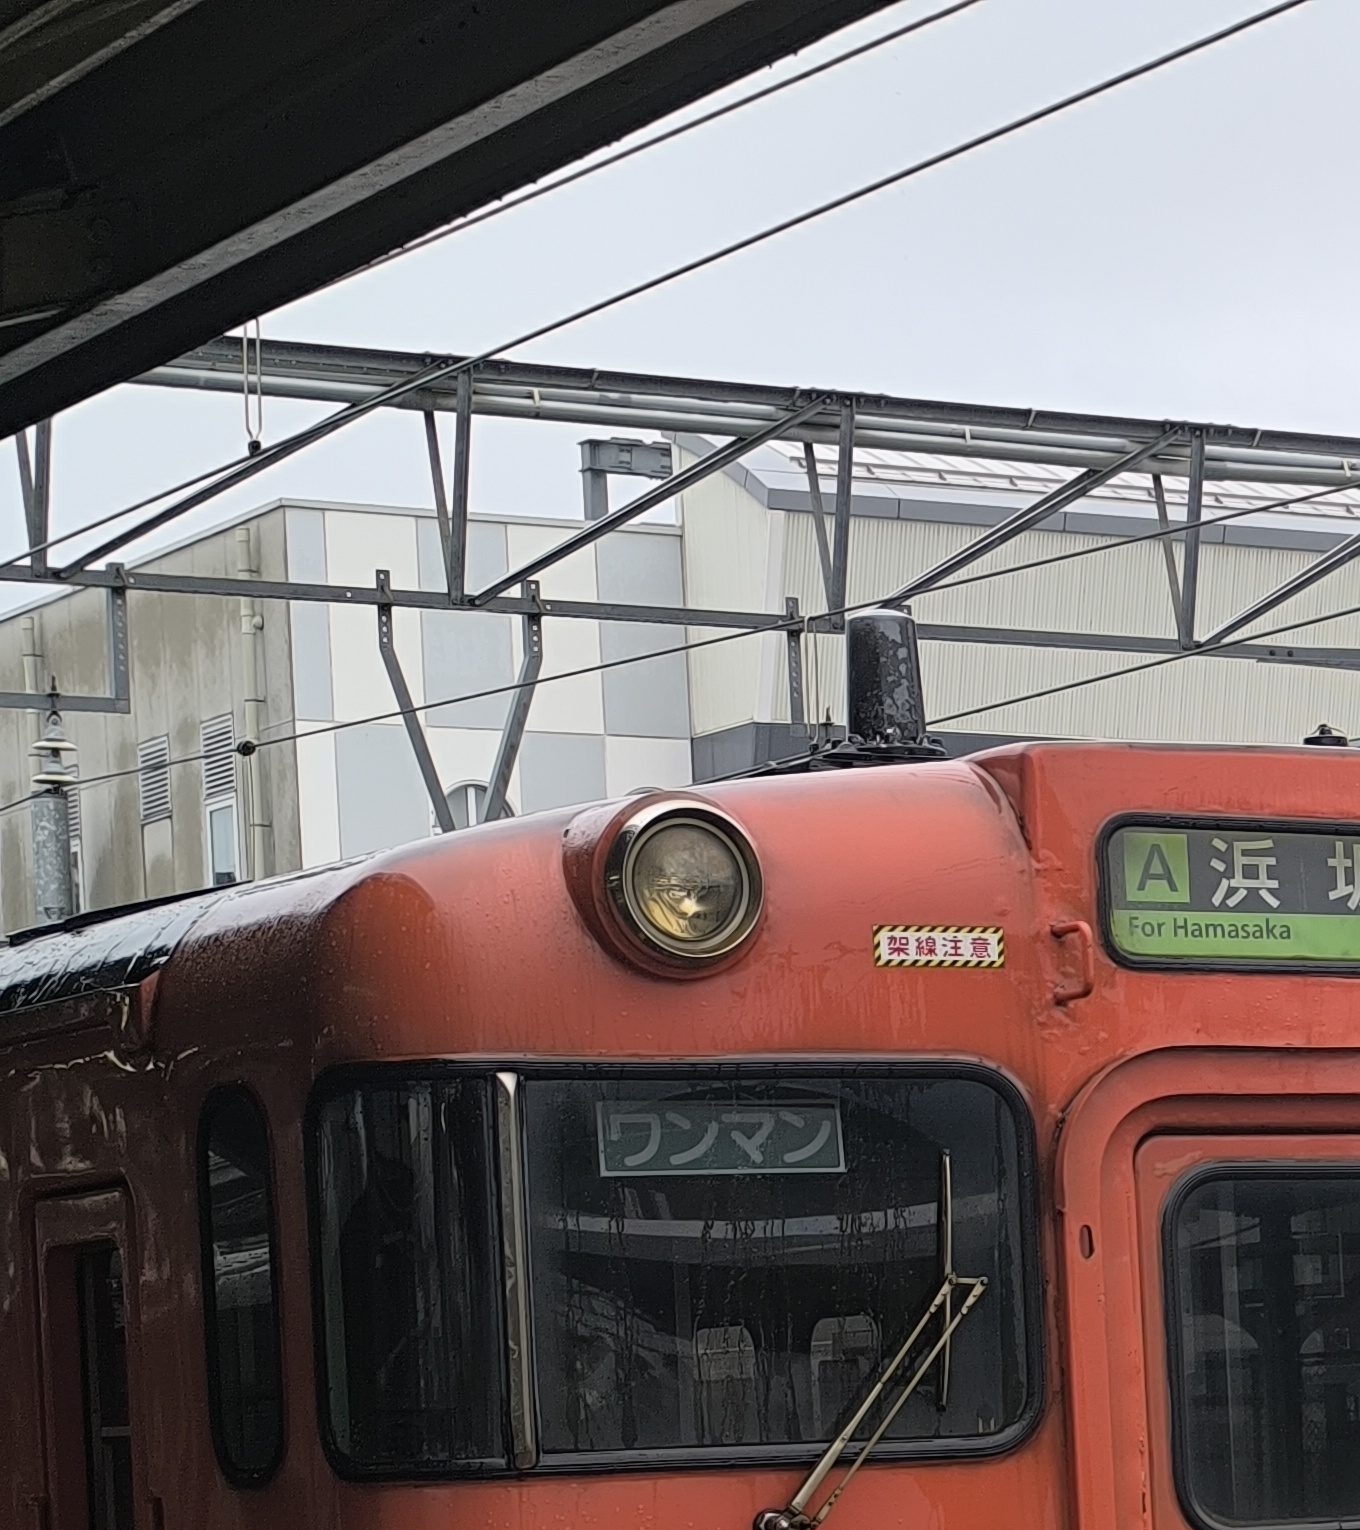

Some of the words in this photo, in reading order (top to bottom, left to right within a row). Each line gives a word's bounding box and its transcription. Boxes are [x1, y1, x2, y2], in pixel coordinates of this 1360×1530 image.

[1136, 843, 1179, 893] A
[886, 934, 992, 959] 架線注意
[1128, 916, 1166, 938] For
[1172, 917, 1292, 940] Hamasaka
[609, 1110, 832, 1167] ワンマン
